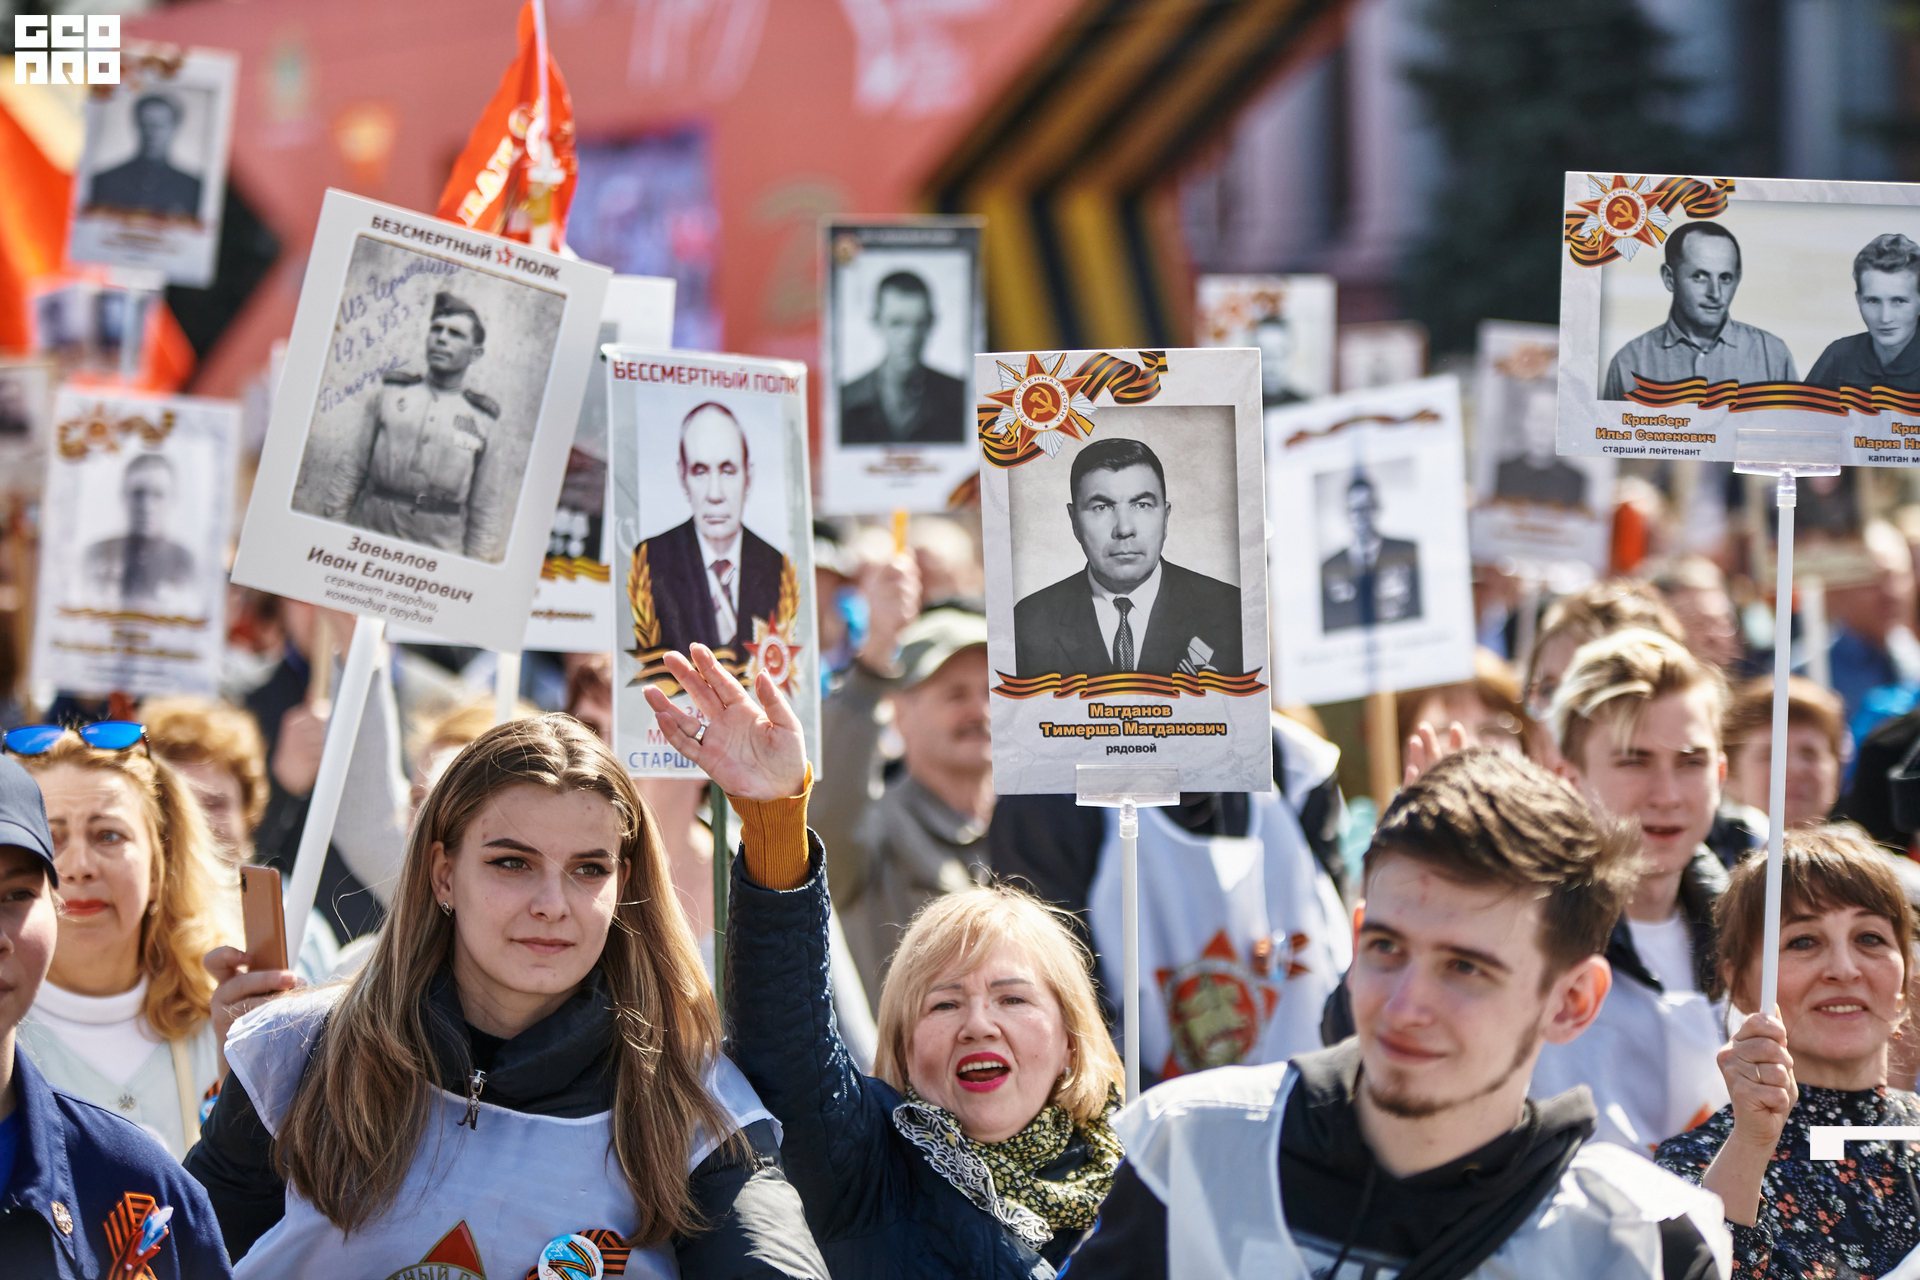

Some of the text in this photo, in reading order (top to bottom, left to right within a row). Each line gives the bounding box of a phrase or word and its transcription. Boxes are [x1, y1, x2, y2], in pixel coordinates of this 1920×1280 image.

[371, 215, 560, 280] БЕЗСМЕРТНЫЙ ПОЛК
[613, 360, 801, 395] БЕССМЕРТНЫЙ ПОЛК
[1622, 413, 1691, 429] Кринберг
[1892, 422, 1920, 436] Кри
[1596, 427, 1716, 443] Илья Семенович
[1854, 435, 1901, 451] Мария
[1602, 445, 1701, 456] старший лейтенант
[1868, 454, 1909, 463] капитан
[347, 535, 438, 572] Завьялов
[307, 546, 474, 604] Иван Елизарович
[324, 573, 440, 614] сержант гвардии,
[324, 588, 434, 625] командир орудия
[1088, 703, 1172, 720] Магданов
[1040, 721, 1227, 739] Тимерша Магданович
[1105, 743, 1157, 756] рядовой
[628, 752, 698, 769] СТАРШ
